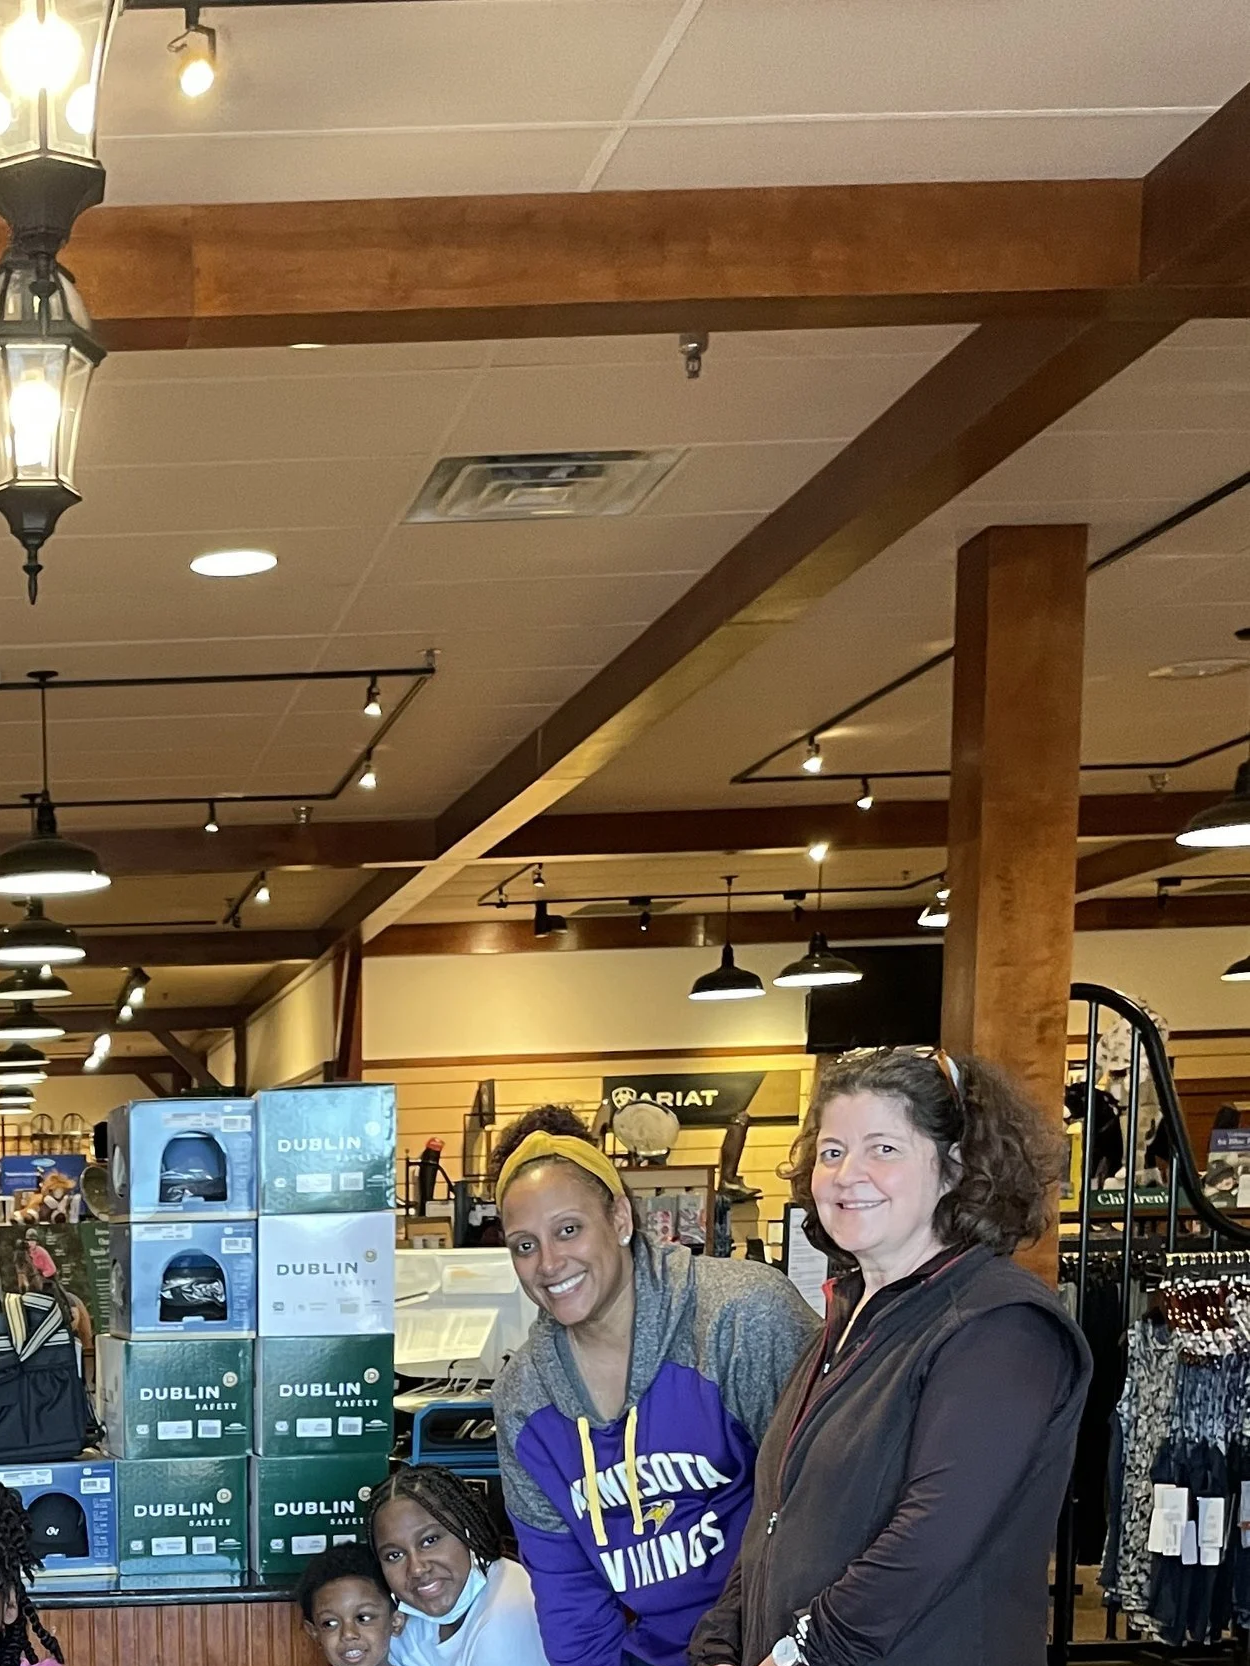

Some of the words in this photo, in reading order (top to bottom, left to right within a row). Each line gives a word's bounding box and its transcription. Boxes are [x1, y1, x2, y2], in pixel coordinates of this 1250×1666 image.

[277, 1136, 362, 1153] DUBLIN
[1097, 1191, 1169, 1206] Chiren'
[276, 1262, 358, 1276] DUBLIN
[139, 1385, 221, 1401] DUBLIN
[279, 1382, 361, 1397] DUBLIN
[195, 1402, 238, 1411] SAFETY
[335, 1399, 379, 1408] SAFETY
[570, 1453, 734, 1520] MNESOTA
[134, 1501, 214, 1518] DUBLIN
[274, 1500, 356, 1516] DUBLIN
[188, 1518, 232, 1527] SAFETY
[330, 1517, 365, 1525] SAFET
[599, 1511, 726, 1593] VIKINGS
